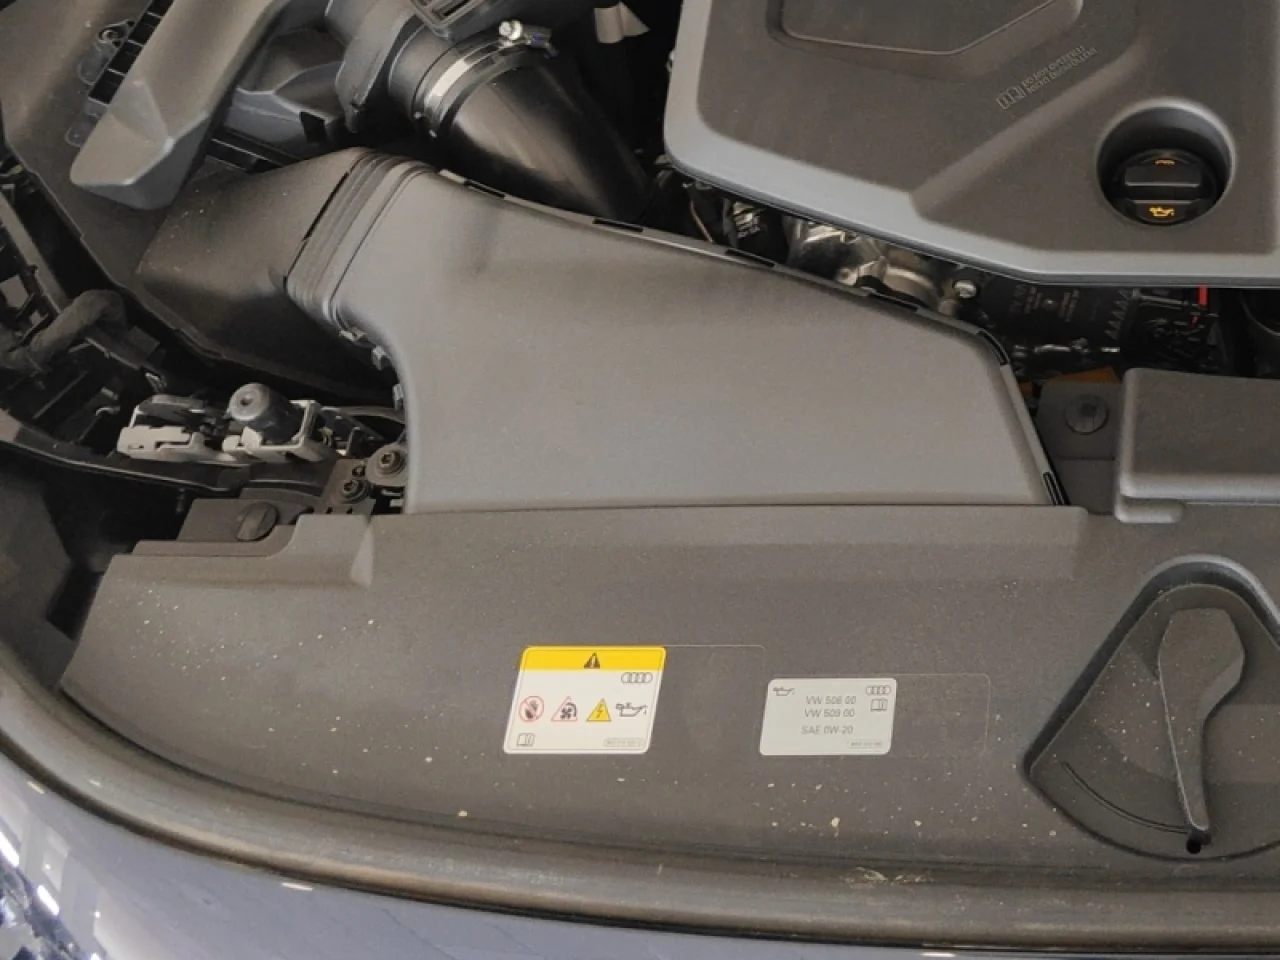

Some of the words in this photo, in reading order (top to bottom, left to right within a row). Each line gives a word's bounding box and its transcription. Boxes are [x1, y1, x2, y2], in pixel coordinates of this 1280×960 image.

[806, 695, 823, 705] VW
[844, 695, 857, 705] 00
[804, 708, 822, 718] VW
[843, 708, 855, 718] 00
[823, 725, 854, 735] 0W-20
